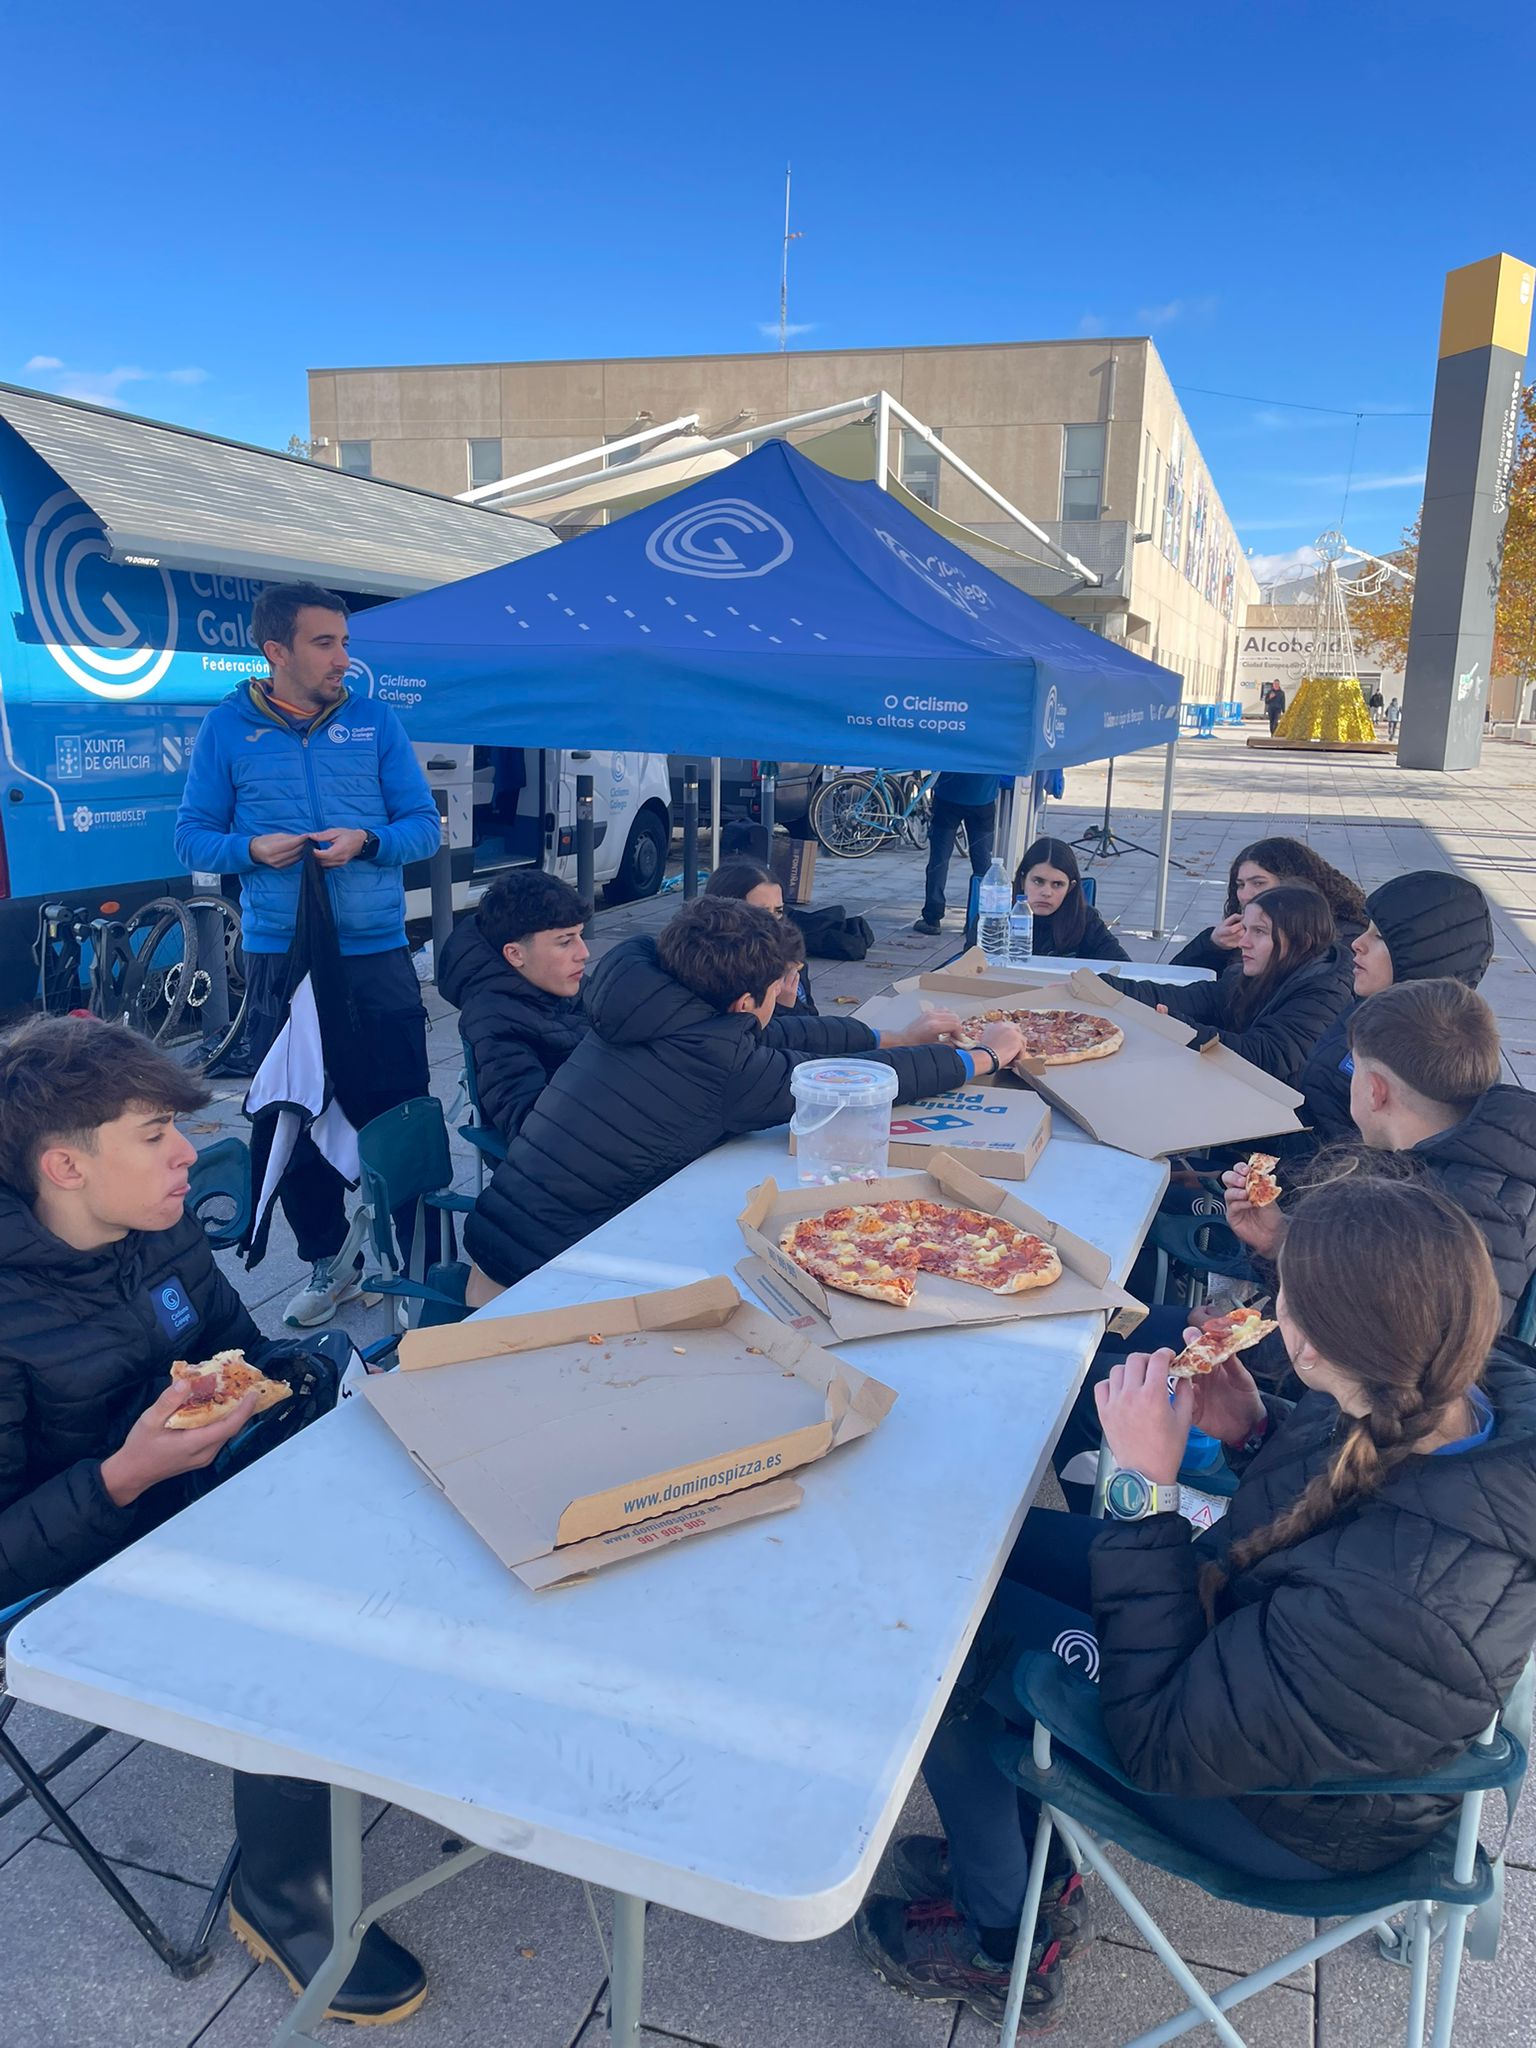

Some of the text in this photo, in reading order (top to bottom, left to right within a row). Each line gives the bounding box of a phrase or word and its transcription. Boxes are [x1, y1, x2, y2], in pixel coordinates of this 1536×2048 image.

[1498, 409, 1509, 467] deportiva
[190, 572, 263, 602] Ciclis
[197, 609, 258, 649] Gale
[202, 656, 270, 674] Federación
[379, 674, 427, 688] Ciclismo
[378, 689, 422, 704] Galego
[884, 695, 969, 712] O Ciclismo
[847, 714, 966, 734] nas altas copas
[84, 739, 126, 754] XUNTA
[85, 755, 150, 771] DE GALICIA
[94, 809, 147, 824] OTTOBOSLEY
[937, 1090, 985, 1104] Piz
[907, 1100, 1009, 1115] Domin
[623, 1453, 782, 1514] www.dominospizza.es
[603, 1504, 722, 1546] www.dominospizza.es
[637, 1518, 707, 1545] 901 905 905
